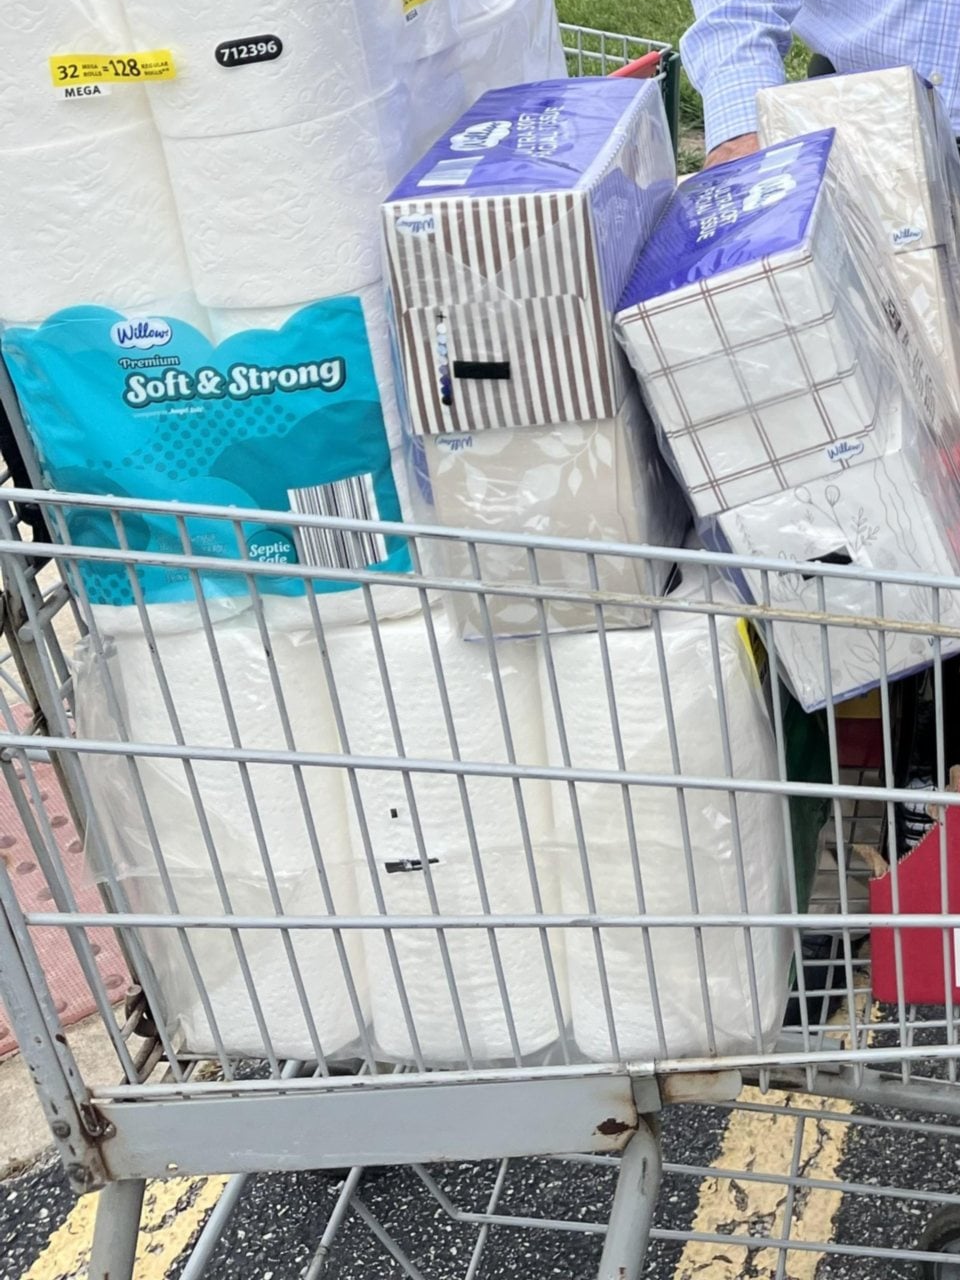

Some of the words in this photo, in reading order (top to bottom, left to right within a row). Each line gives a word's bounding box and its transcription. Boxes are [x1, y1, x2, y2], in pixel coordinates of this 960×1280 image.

[220, 40, 278, 61] 712396
[57, 64, 80, 81] 32
[64, 85, 101, 98] MEGA
[516, 112, 538, 132] SOFT
[538, 105, 565, 131] TISSUE
[117, 323, 164, 344] Willow
[120, 355, 179, 369] Premium
[126, 370, 191, 404] Soft
[197, 370, 223, 395] &
[228, 358, 341, 396] Strong
[827, 441, 862, 460] Willow
[250, 541, 281, 557] Septic
